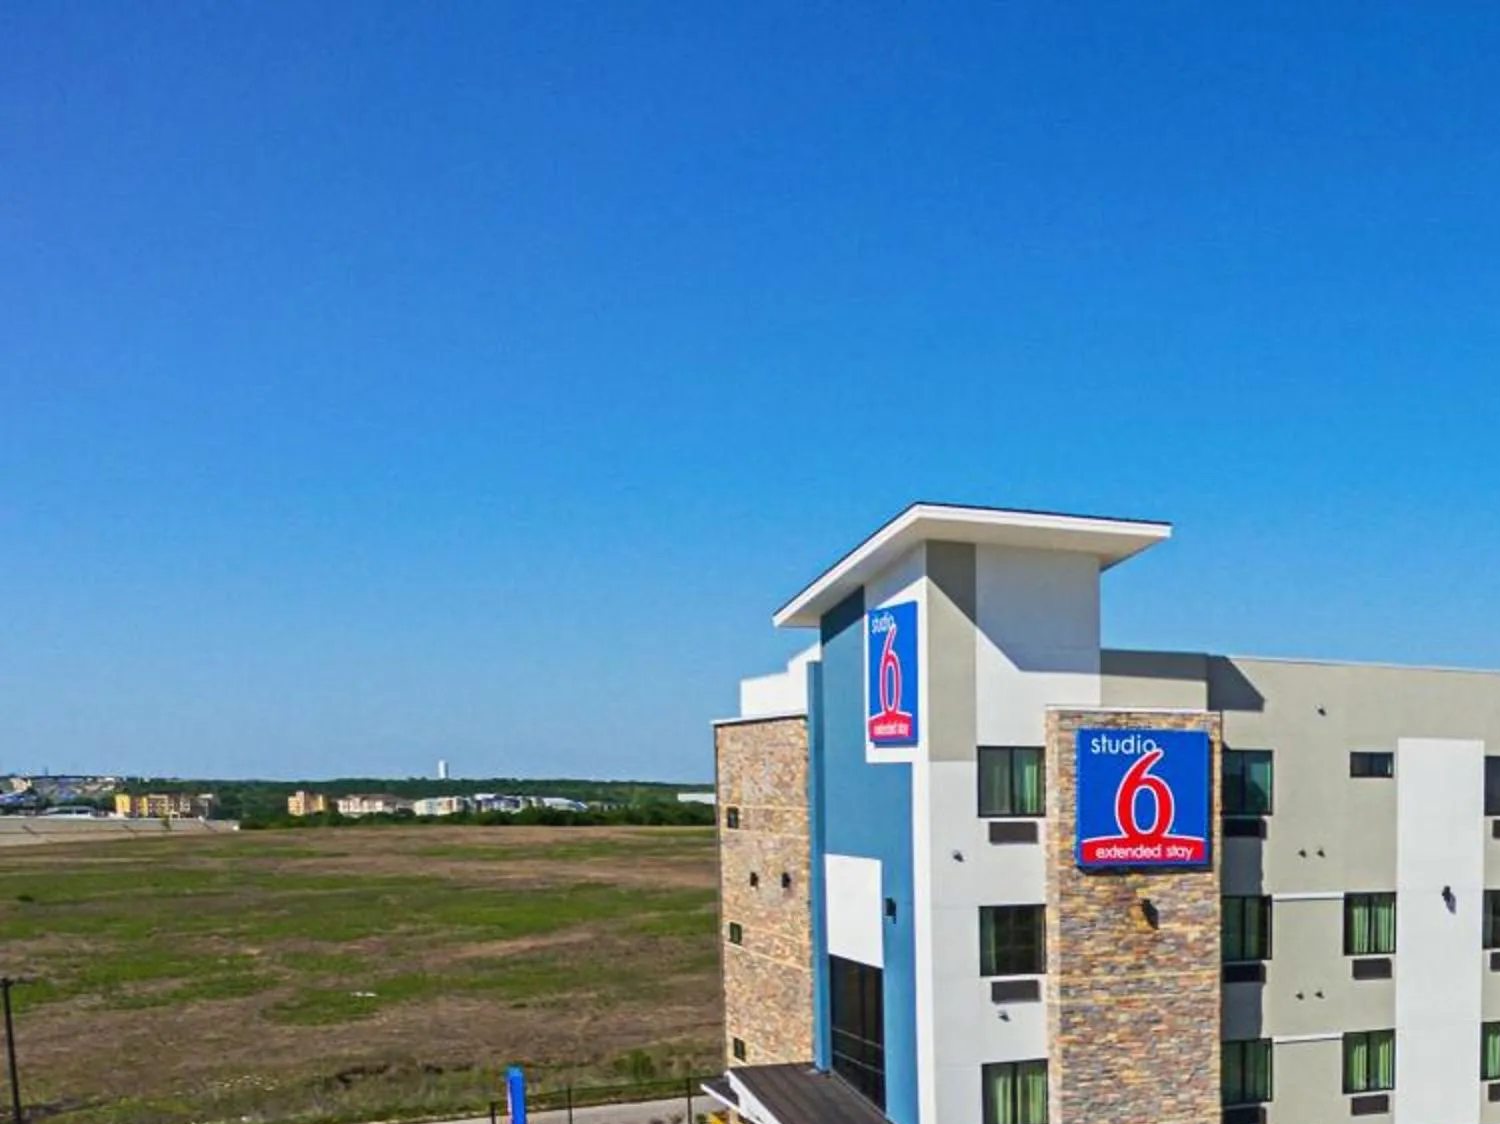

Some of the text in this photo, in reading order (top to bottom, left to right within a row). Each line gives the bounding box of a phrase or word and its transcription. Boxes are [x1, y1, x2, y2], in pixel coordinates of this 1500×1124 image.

[880, 622, 902, 712] 6
[1090, 733, 1157, 755] studio
[1115, 748, 1175, 838] 6
[1095, 844, 1195, 861] extended stay
